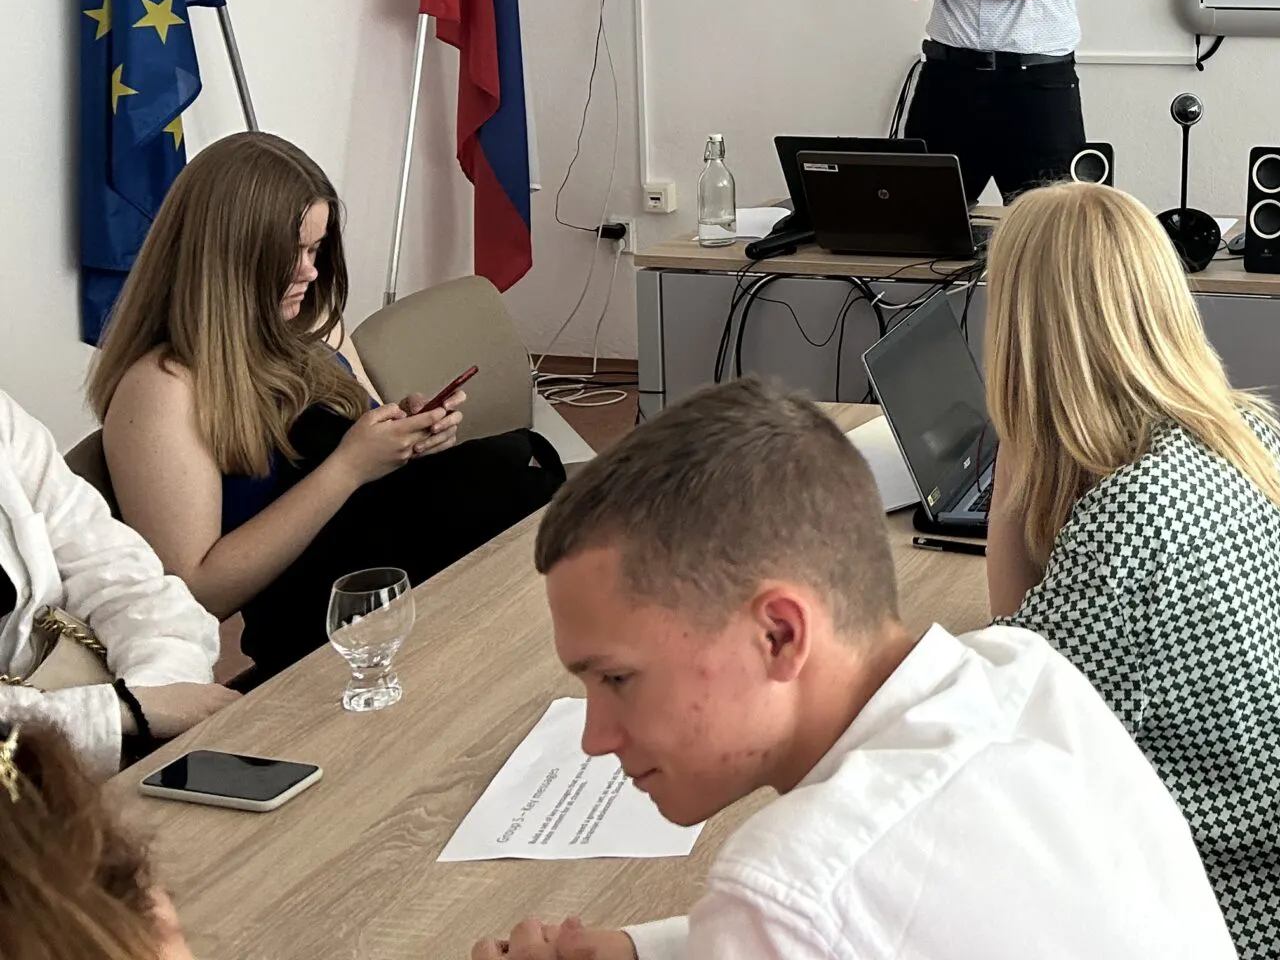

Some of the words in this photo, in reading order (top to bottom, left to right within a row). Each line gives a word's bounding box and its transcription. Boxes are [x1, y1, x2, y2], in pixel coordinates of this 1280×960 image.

[496, 823, 522, 843] Group
[520, 800, 540, 811] Key
[532, 767, 560, 799] messages
